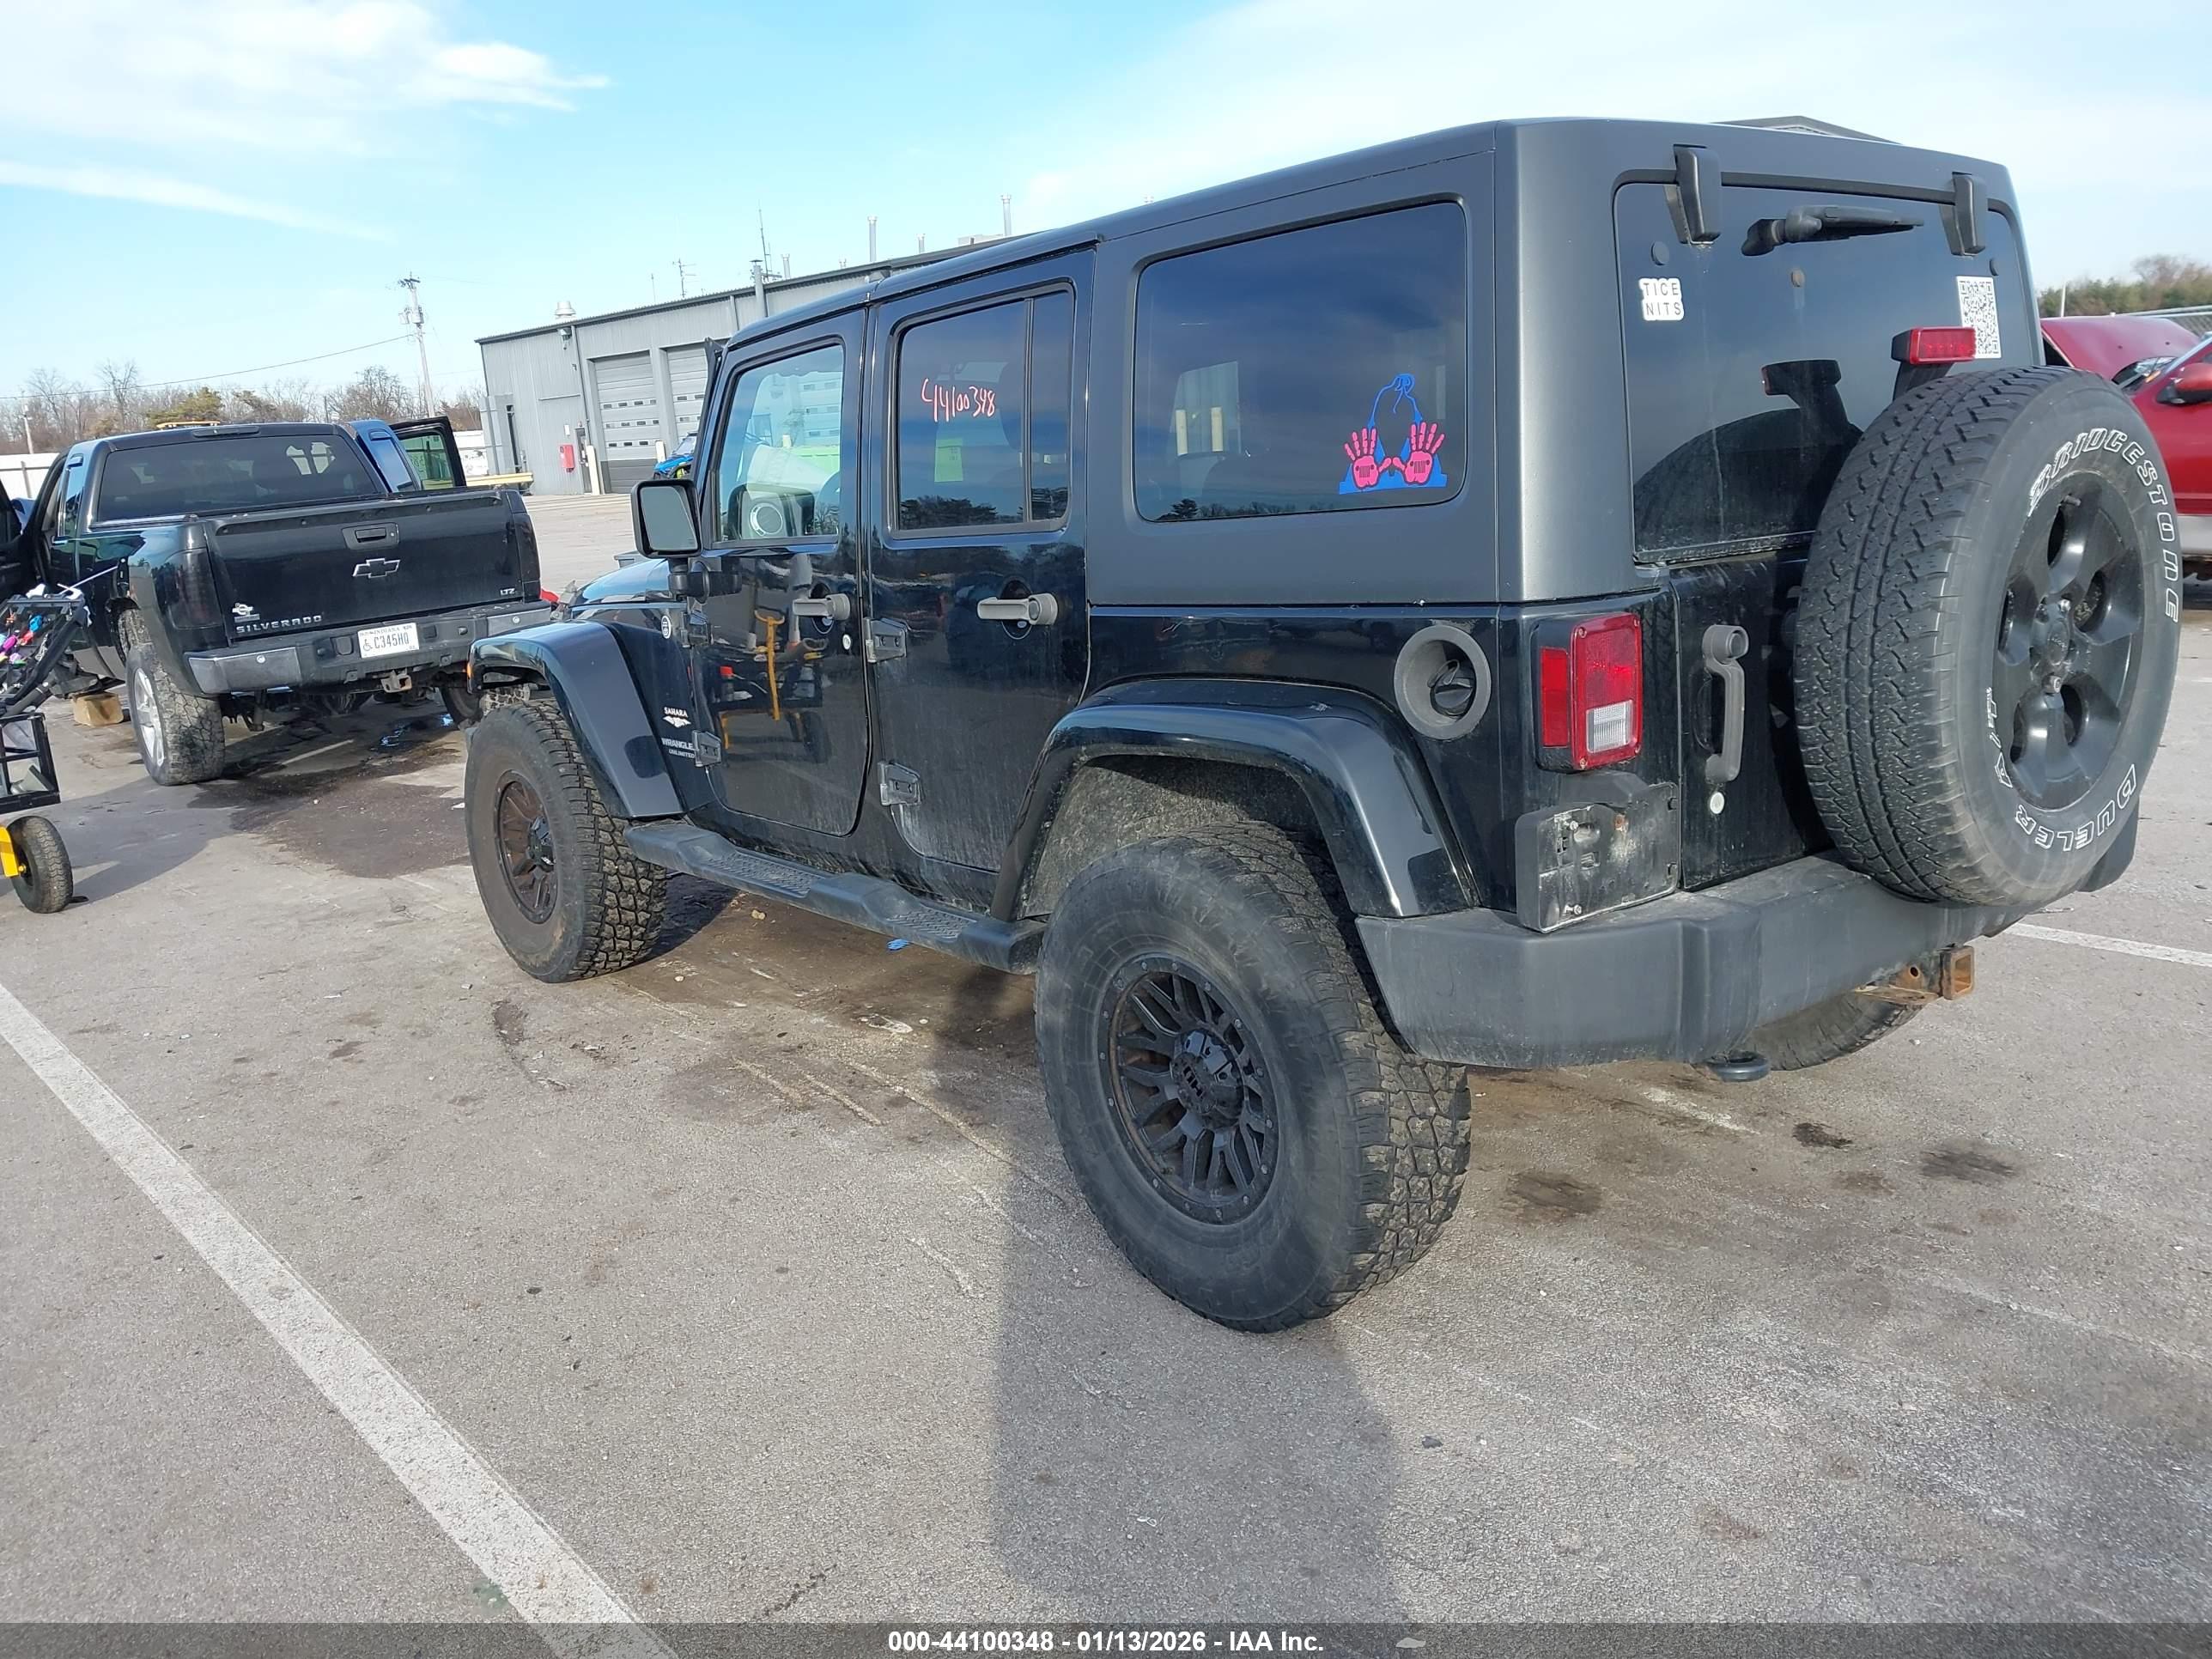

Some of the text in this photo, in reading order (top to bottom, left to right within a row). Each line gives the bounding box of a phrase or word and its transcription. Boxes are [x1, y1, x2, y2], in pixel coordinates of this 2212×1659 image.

[1643, 283, 1679, 296] TICE
[1645, 301, 1681, 316] NITS
[921, 378, 996, 422] 44100348
[2027, 428, 2179, 623] BRIDGESTONE
[500, 587, 516, 596] LTZ
[236, 615, 322, 634] SILVERADO
[664, 707, 689, 718] SAHARA
[660, 737, 696, 751] WRANGLE
[2014, 763, 2137, 852] DUELER
